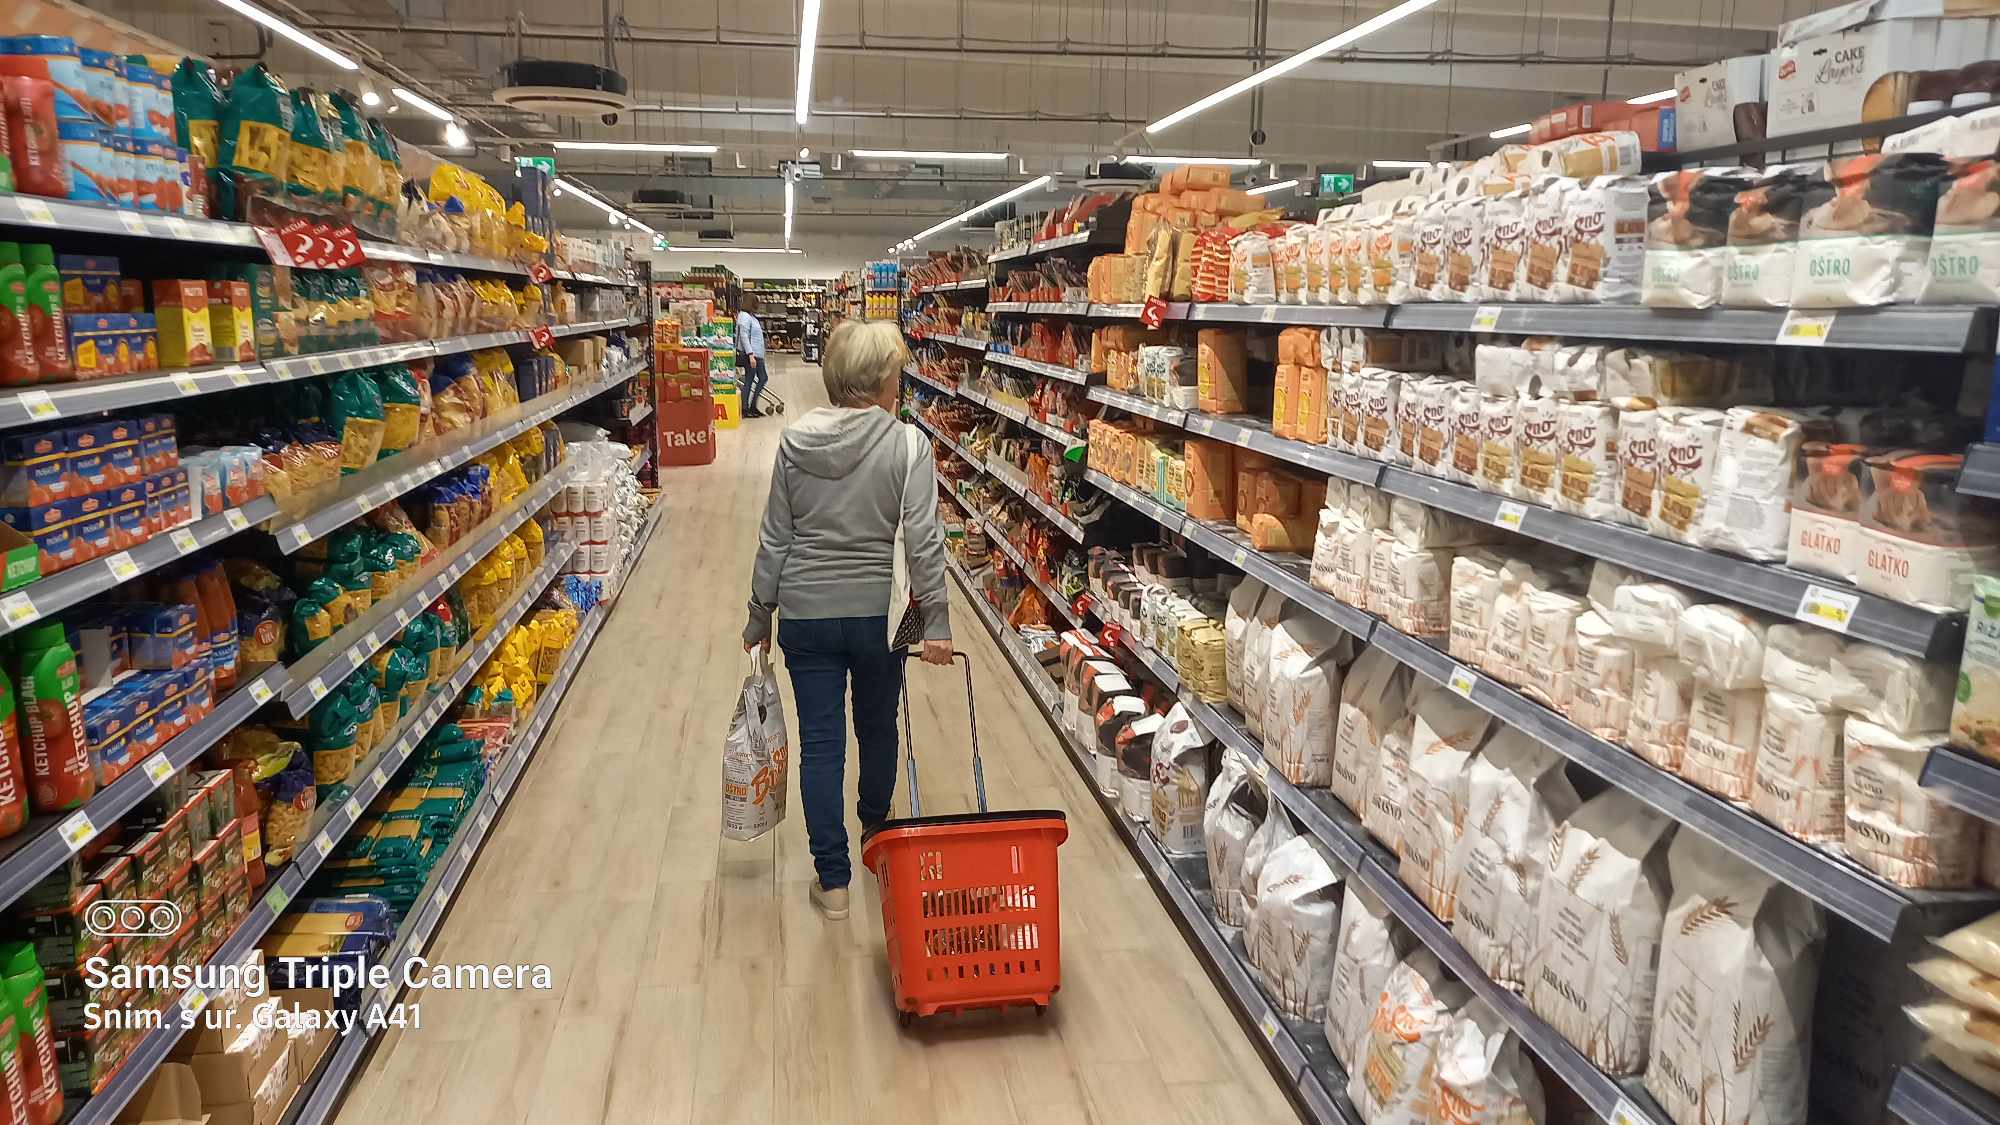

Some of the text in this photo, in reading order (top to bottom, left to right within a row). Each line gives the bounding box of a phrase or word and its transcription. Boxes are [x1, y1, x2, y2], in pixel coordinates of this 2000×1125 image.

[1835, 46, 1865, 63] CAKE
[1815, 57, 1865, 84] Layers
[1809, 254, 1851, 277] OŠTRO
[1932, 253, 1979, 276] OŠTRO
[663, 429, 707, 448] Take
[1800, 528, 1841, 555] GLATKO
[1867, 549, 1910, 578] GLATKO
[63, 692, 90, 775] KETCHUP
